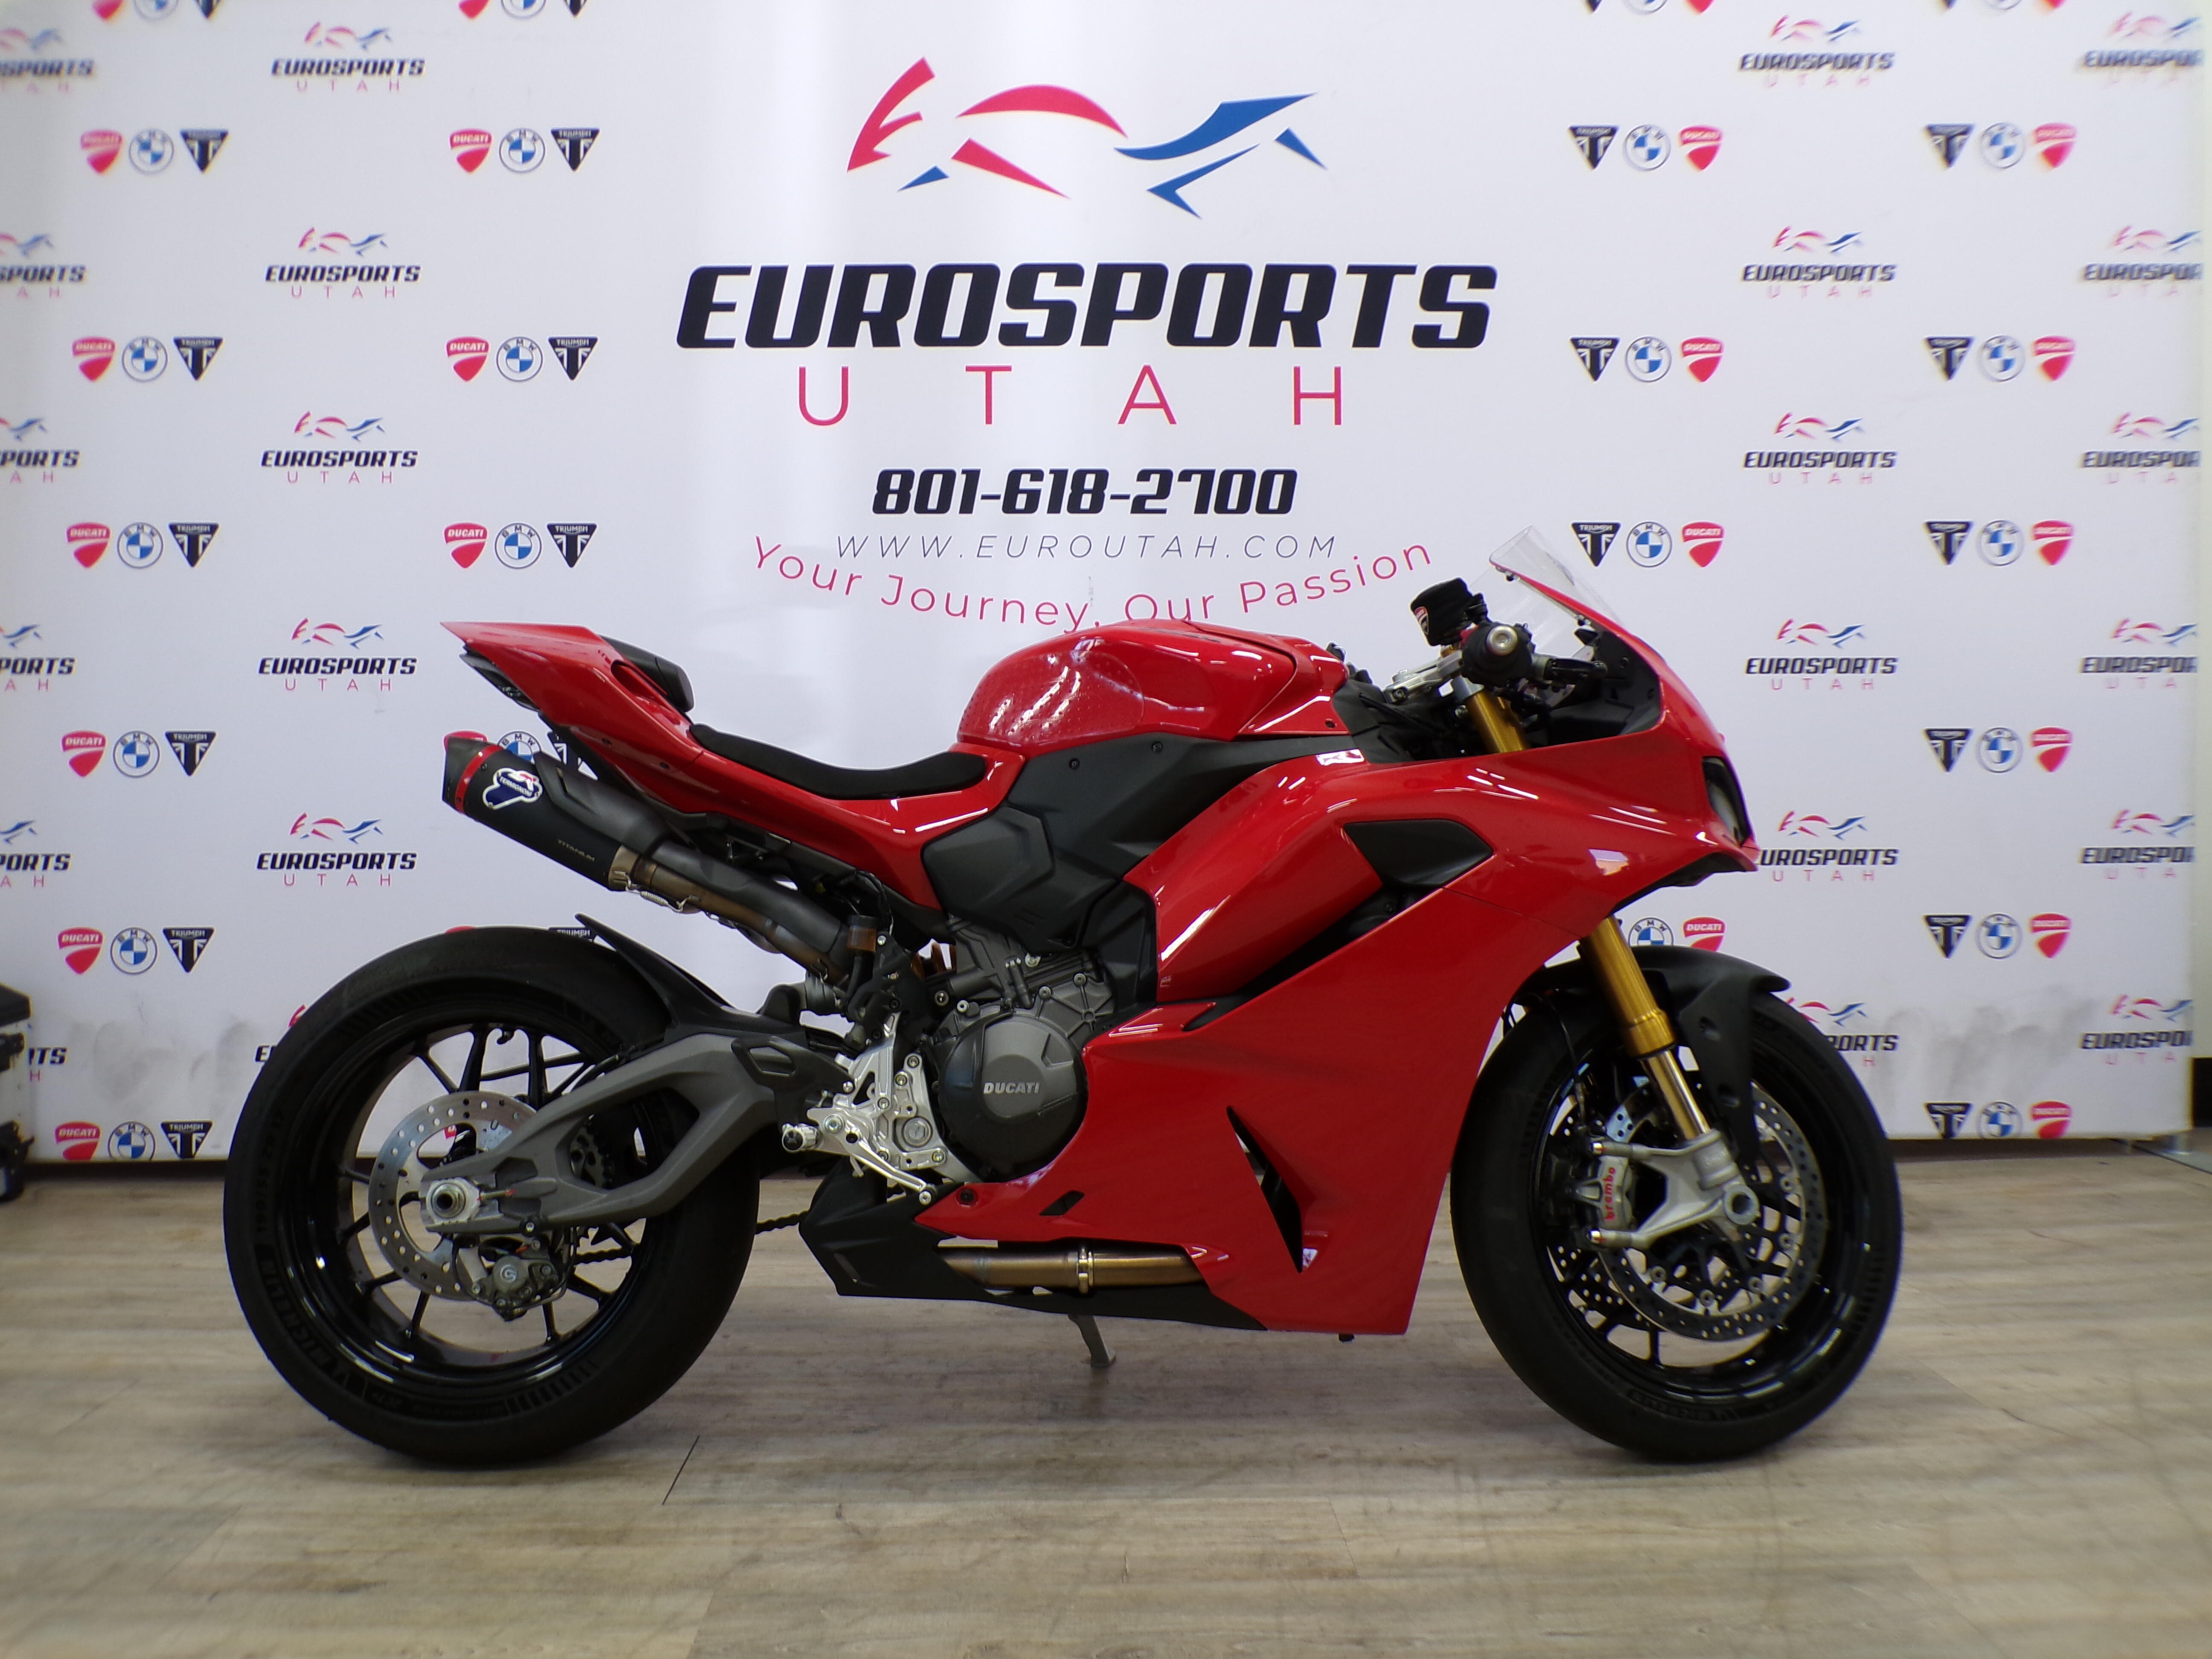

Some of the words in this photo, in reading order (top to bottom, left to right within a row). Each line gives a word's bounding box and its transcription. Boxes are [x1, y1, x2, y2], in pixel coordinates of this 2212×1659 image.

[271, 59, 425, 76] EUROSPORTS
[1740, 53, 1895, 71] EUROSPORTS
[453, 134, 489, 144] DUCATI
[265, 265, 421, 282] EUROSPORTS
[1743, 265, 1897, 282] EUROSPORTS
[291, 286, 396, 299] UTAH
[676, 263, 1497, 348] EUROSPORTS
[449, 341, 486, 352] DUCATI
[502, 338, 536, 352] BMW
[799, 365, 1343, 426] UTAH
[261, 451, 418, 467] EUROSPORTS
[1744, 451, 1897, 468] EUROSPORTS
[287, 472, 393, 484] UTAH
[872, 469, 1298, 515] 801-618-2700
[448, 528, 484, 538] DUCATI
[501, 525, 536, 538] BMW
[837, 535, 1336, 559] WWW.EUROUTAH.COM
[755, 535, 863, 596] Your
[880, 573, 1101, 633] Journey,
[1124, 593, 1215, 620] Our
[1240, 543, 1432, 614] Passion
[259, 658, 417, 675] EUROSPORTS
[1746, 658, 1898, 674] EUROSPORTS
[285, 678, 392, 692] UTAH
[65, 737, 102, 745] DUCATI
[501, 733, 536, 747] BMW
[257, 853, 417, 870] EUROSPORTS
[1756, 850, 1897, 866] UROSPORTS
[284, 873, 392, 887] UTAH
[1772, 869, 1875, 882] UTAH
[1634, 920, 1667, 932] BMW
[1687, 923, 1722, 931] DUCATI
[62, 934, 99, 942] DUCATI
[983, 1082, 1040, 1095] DUCATI
[58, 1129, 96, 1137] DUCATI
[1603, 1167, 1616, 1221] brembo
